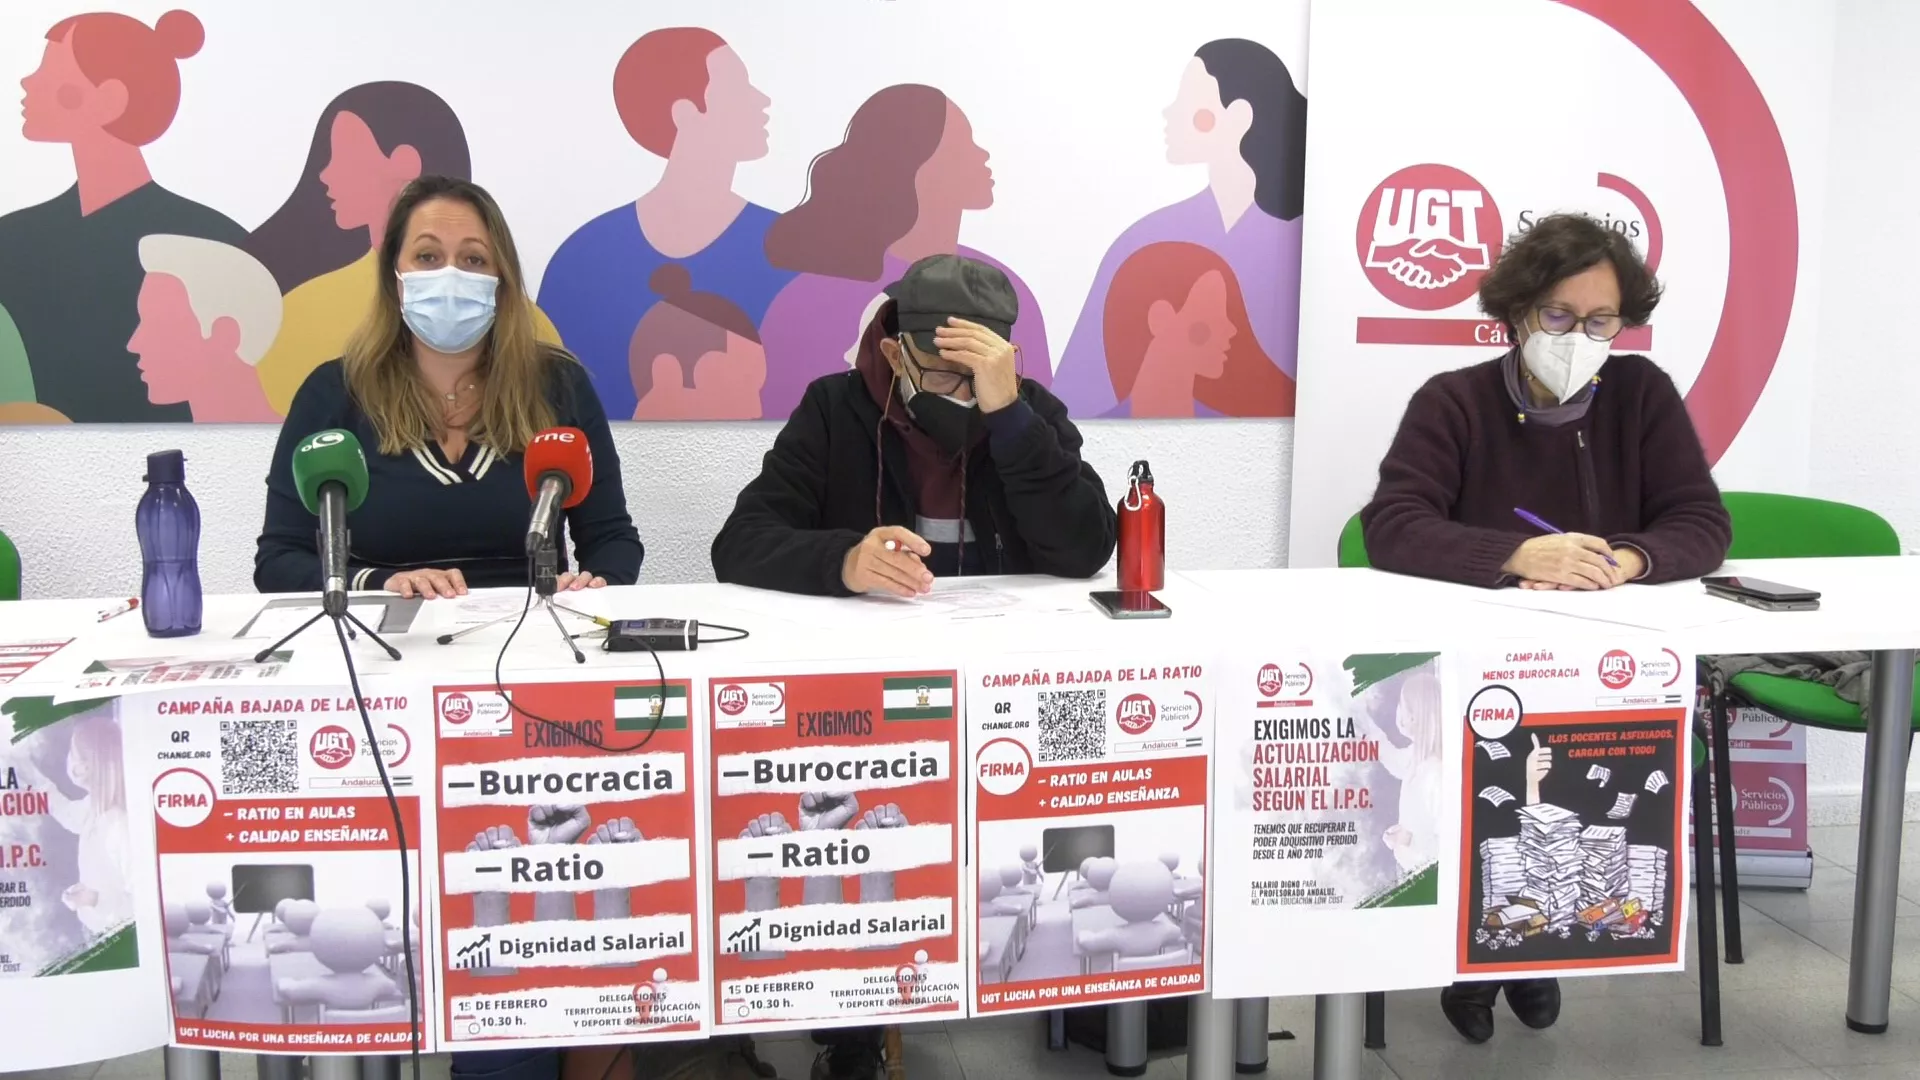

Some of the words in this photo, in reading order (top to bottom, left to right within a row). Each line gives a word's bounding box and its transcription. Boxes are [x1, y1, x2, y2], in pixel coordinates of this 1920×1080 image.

[1372, 187, 1484, 246] UGT
[534, 432, 576, 443] rne
[1506, 649, 1554, 662] CAMPAÑA
[1603, 655, 1632, 672] UGT
[982, 669, 1051, 687] CAMPAÑA
[1056, 669, 1112, 684] BAJADA
[1118, 669, 1135, 681] DE
[1140, 667, 1158, 680] LA
[1162, 665, 1203, 680] RATIO
[1260, 668, 1280, 682] UGT
[1482, 670, 1515, 681] MENOS
[1518, 668, 1580, 679] BUROCRACIA
[720, 690, 745, 703] UGT
[158, 697, 234, 715] CAMPAÑA
[241, 698, 304, 713] BAJADA
[311, 698, 330, 712] DE
[336, 697, 358, 711] LA
[362, 696, 407, 710] RATIO
[445, 698, 470, 711] UGT
[994, 702, 1012, 715] QR
[1121, 699, 1152, 718] UGT
[1160, 703, 1192, 713] Servicios
[1160, 713, 1190, 722] Públicos
[1472, 707, 1515, 722] FIRMA
[797, 710, 873, 737] EXIGIMOS
[981, 720, 1030, 731] CHANGE.ORG
[1254, 718, 1331, 740] EXIGIMOS
[1336, 717, 1356, 738] LA
[171, 730, 190, 744] QR
[314, 731, 350, 749] UGT
[524, 719, 604, 749] EXIGIMOS
[1571, 731, 1617, 742] DOCENTES
[157, 750, 211, 760] CHANGE.ORG
[1253, 734, 1379, 764] ACTUALIZACIÓN
[1568, 748, 1605, 758] CARGAN
[1607, 747, 1626, 756] CON
[754, 751, 938, 784] Burocracia
[979, 761, 1025, 778] FIRMA
[480, 762, 673, 795] Burocracia
[1050, 772, 1088, 787] RATIO
[1091, 771, 1108, 784] EN
[1112, 767, 1153, 782] AULAS
[1253, 766, 1331, 788] SALARIAL
[158, 794, 208, 808] FIRMA
[1050, 793, 1104, 809] CALIDAD
[1107, 785, 1180, 804] ENSEÑANZA
[1252, 784, 1305, 811] SEGÚN
[1311, 790, 1328, 810] EL
[1333, 788, 1373, 809] I.P.C.
[1741, 788, 1786, 800] Servicios
[237, 806, 280, 819] RATIO
[284, 806, 305, 819] EN
[309, 805, 355, 818] AULAS
[1741, 800, 1783, 810] Públicos
[239, 828, 300, 843] CALIDAD
[304, 825, 389, 842] ENSEÑANZA
[1253, 823, 1286, 835] TENEMOS
[1287, 823, 1302, 835] QUE
[1304, 822, 1346, 834] RECUPERAR
[1347, 821, 1356, 832] EL
[1253, 836, 1277, 847] PODER
[1279, 835, 1325, 849] ADQUISITIVO
[1326, 834, 1358, 845] PERDIDO
[781, 838, 871, 868] Ratio
[1253, 848, 1276, 860] DESDE
[1277, 848, 1285, 859] EL
[1287, 846, 1302, 859] AÑO
[1304, 848, 1323, 859] 2010.
[510, 854, 604, 883] Ratio
[1251, 881, 1279, 889] SALARIO
[1280, 880, 1300, 888] DIGNO
[1302, 879, 1317, 887] PARA
[1259, 888, 1305, 897] PROFESORADO
[769, 920, 861, 942] Dignidad
[867, 914, 945, 934] Salarial
[500, 935, 596, 959] Dignidad
[603, 931, 685, 951] Salarial
[863, 973, 928, 984] DELEGACIONES
[728, 984, 741, 995] 15
[745, 984, 760, 994] DE
[762, 981, 814, 993] FEBRERO
[830, 987, 895, 998] TERRITORIALES
[897, 986, 909, 995] DE
[910, 982, 960, 993] EDUCACIÓN
[981, 994, 1001, 1004] UGT
[1003, 991, 1036, 1002] LUCHA
[1039, 988, 1058, 999] POR
[1061, 985, 1082, 996] UNA
[1084, 978, 1142, 994] ENSEÑANZA
[1144, 977, 1158, 988] DE
[1160, 973, 1201, 987] CALIDAD
[599, 991, 667, 1002] DELEGACIONES
[750, 999, 780, 1010] 10.30
[782, 998, 794, 1009] h.
[838, 1001, 845, 1009] Y
[846, 999, 885, 1008] DEPORTE
[901, 994, 953, 1006] ANDALUCÍA
[458, 1001, 472, 1011] 15
[475, 1001, 491, 1011] DE
[494, 998, 548, 1010] FEBRERO
[564, 1005, 633, 1016] TERRITORIALES
[635, 1004, 647, 1013] DE
[649, 1001, 701, 1012] EDUCACIÓN
[481, 1016, 512, 1027] 10.30
[515, 1015, 527, 1026] h.
[573, 1020, 580, 1028] Y
[581, 1018, 622, 1028] DEPORTE
[639, 1013, 694, 1025] ANDALUCÍA
[180, 1028, 200, 1038] UGT
[202, 1029, 236, 1041] LUCHA
[239, 1032, 260, 1042] POR
[262, 1032, 285, 1044] UNA
[288, 1031, 353, 1044] ENSEÑANZA
[357, 1033, 371, 1043] DE
